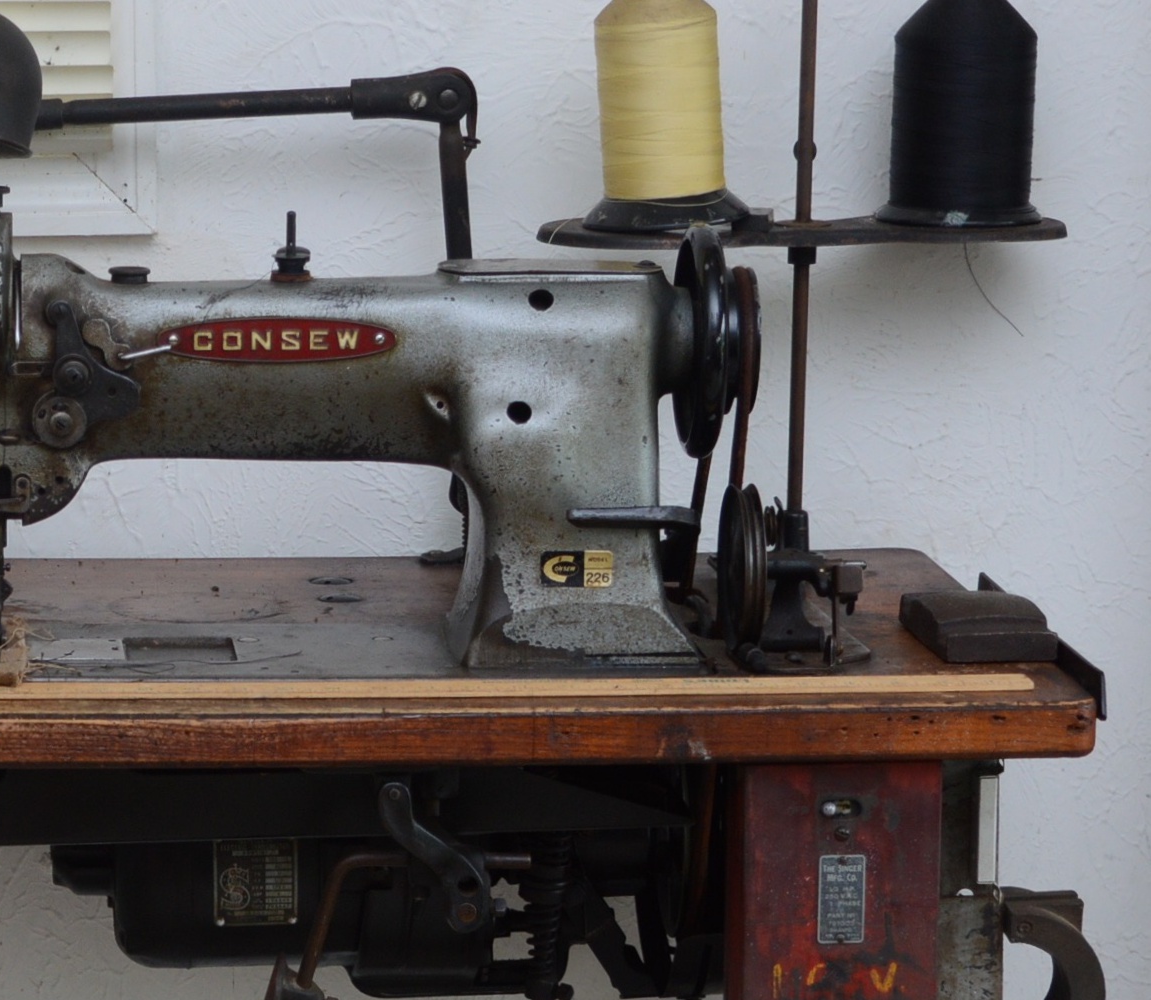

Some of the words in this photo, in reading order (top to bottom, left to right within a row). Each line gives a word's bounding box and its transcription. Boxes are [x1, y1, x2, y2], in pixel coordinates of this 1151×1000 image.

[193, 331, 358, 351] CONSEW
[586, 572, 610, 584] 226
[823, 864, 835, 872] THE
[838, 864, 863, 873] SINGER
